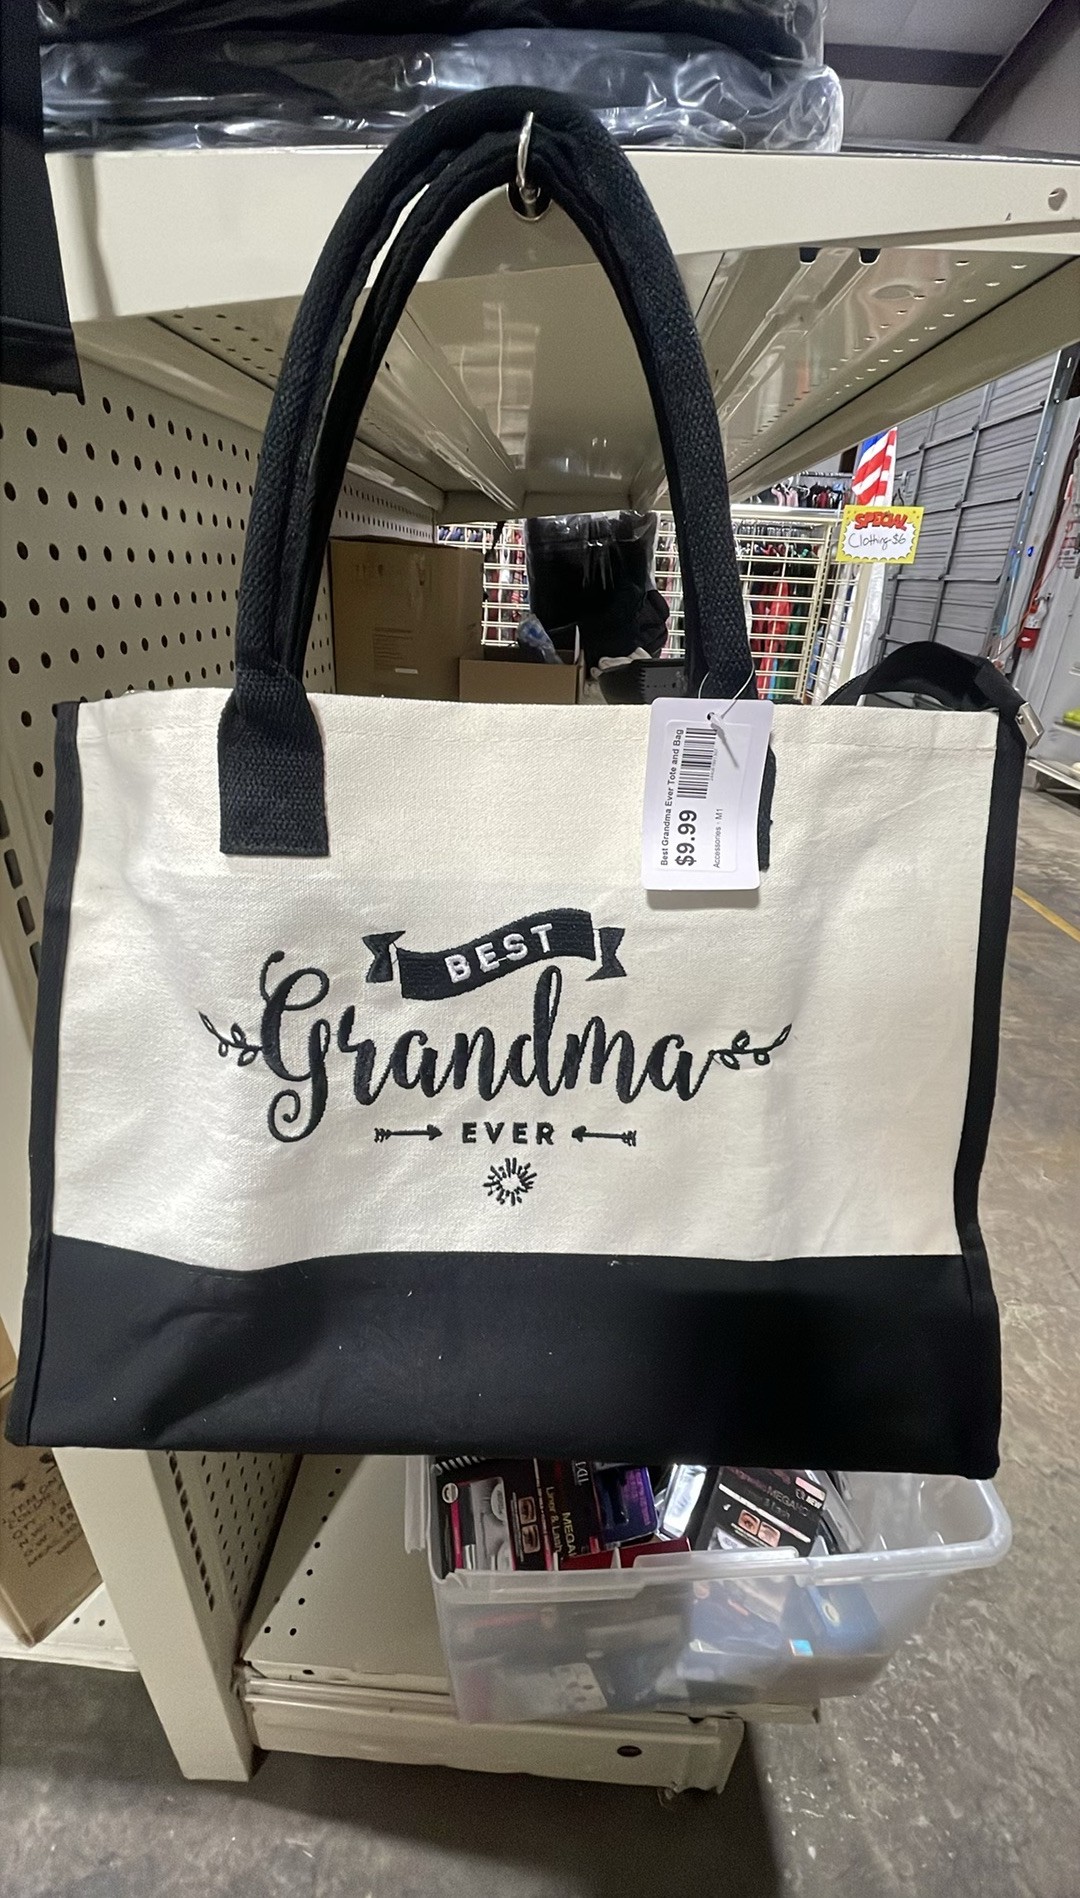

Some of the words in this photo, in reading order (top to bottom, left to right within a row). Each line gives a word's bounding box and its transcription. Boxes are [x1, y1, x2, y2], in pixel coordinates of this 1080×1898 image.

[854, 511, 908, 531] SPECIAL
[673, 729, 684, 746] Bag
[671, 749, 679, 767] and
[667, 767, 677, 786] Tote
[665, 786, 674, 807] Ever
[715, 808, 723, 821] M1
[661, 808, 672, 847] Grandma
[675, 809, 697, 867] $9.99
[661, 847, 671, 866] Best
[713, 826, 722, 869] Accessories
[445, 923, 554, 985] BEST
[260, 950, 718, 1143] Grandma
[462, 1121, 555, 1146] EVER
